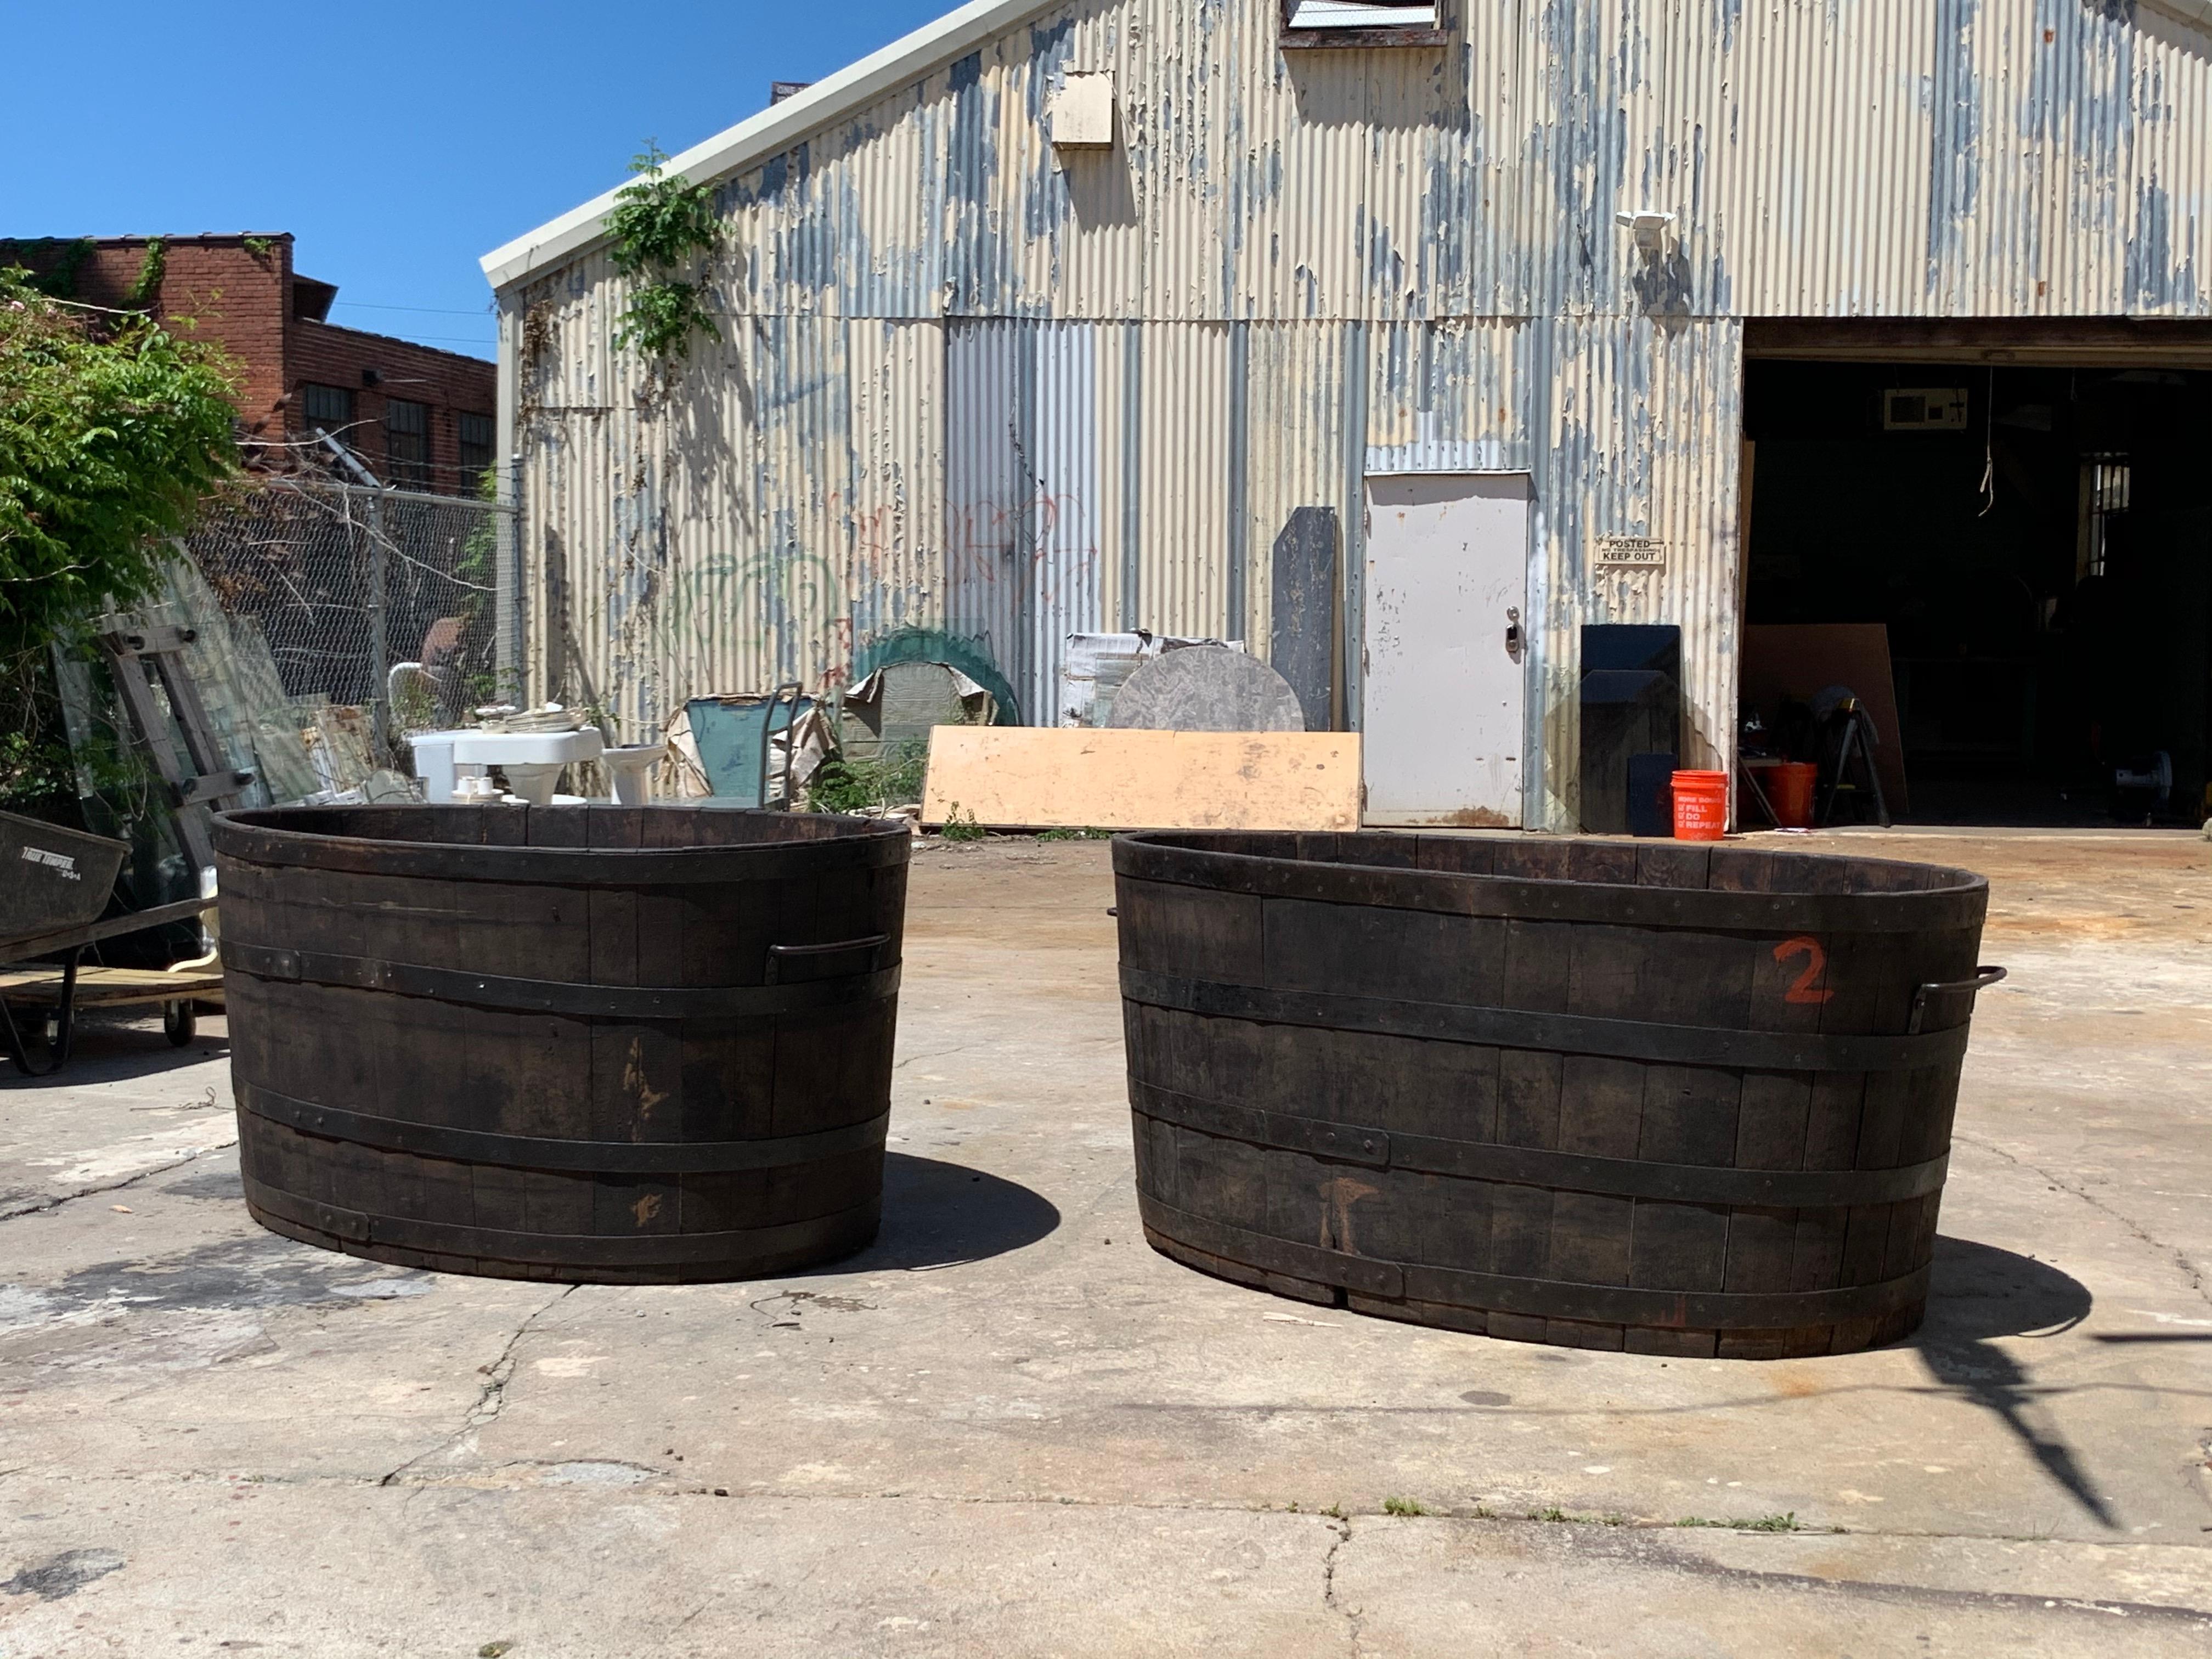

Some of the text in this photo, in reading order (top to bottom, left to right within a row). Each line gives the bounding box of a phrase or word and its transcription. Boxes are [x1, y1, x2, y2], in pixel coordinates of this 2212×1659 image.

[1610, 540, 1650, 548] POSTED
[21, 846, 44, 862] TRUE
[1773, 936, 1835, 1004] 2
